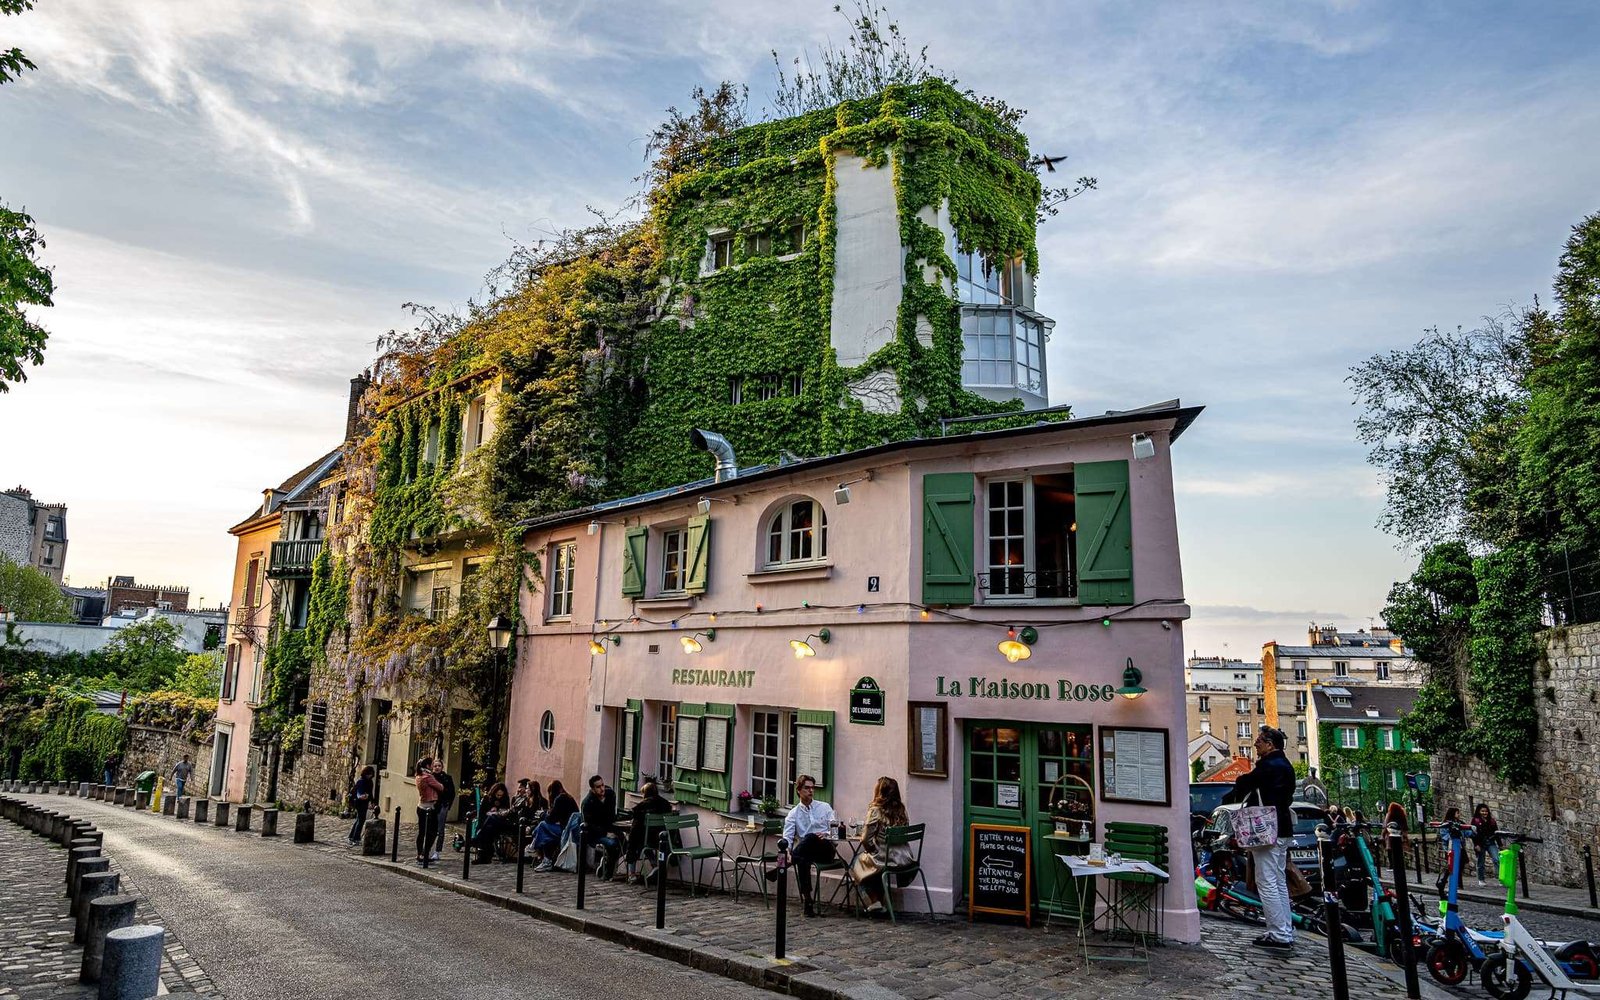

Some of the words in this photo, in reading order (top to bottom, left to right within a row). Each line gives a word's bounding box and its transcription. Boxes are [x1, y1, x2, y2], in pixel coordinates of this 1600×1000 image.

[870, 578, 877, 592] 2
[672, 668, 756, 688] RESTAURANT
[936, 676, 963, 696] La
[969, 677, 1051, 700] Maison
[1057, 679, 1115, 702] Rose
[979, 867, 1012, 878] ENTRANCE
